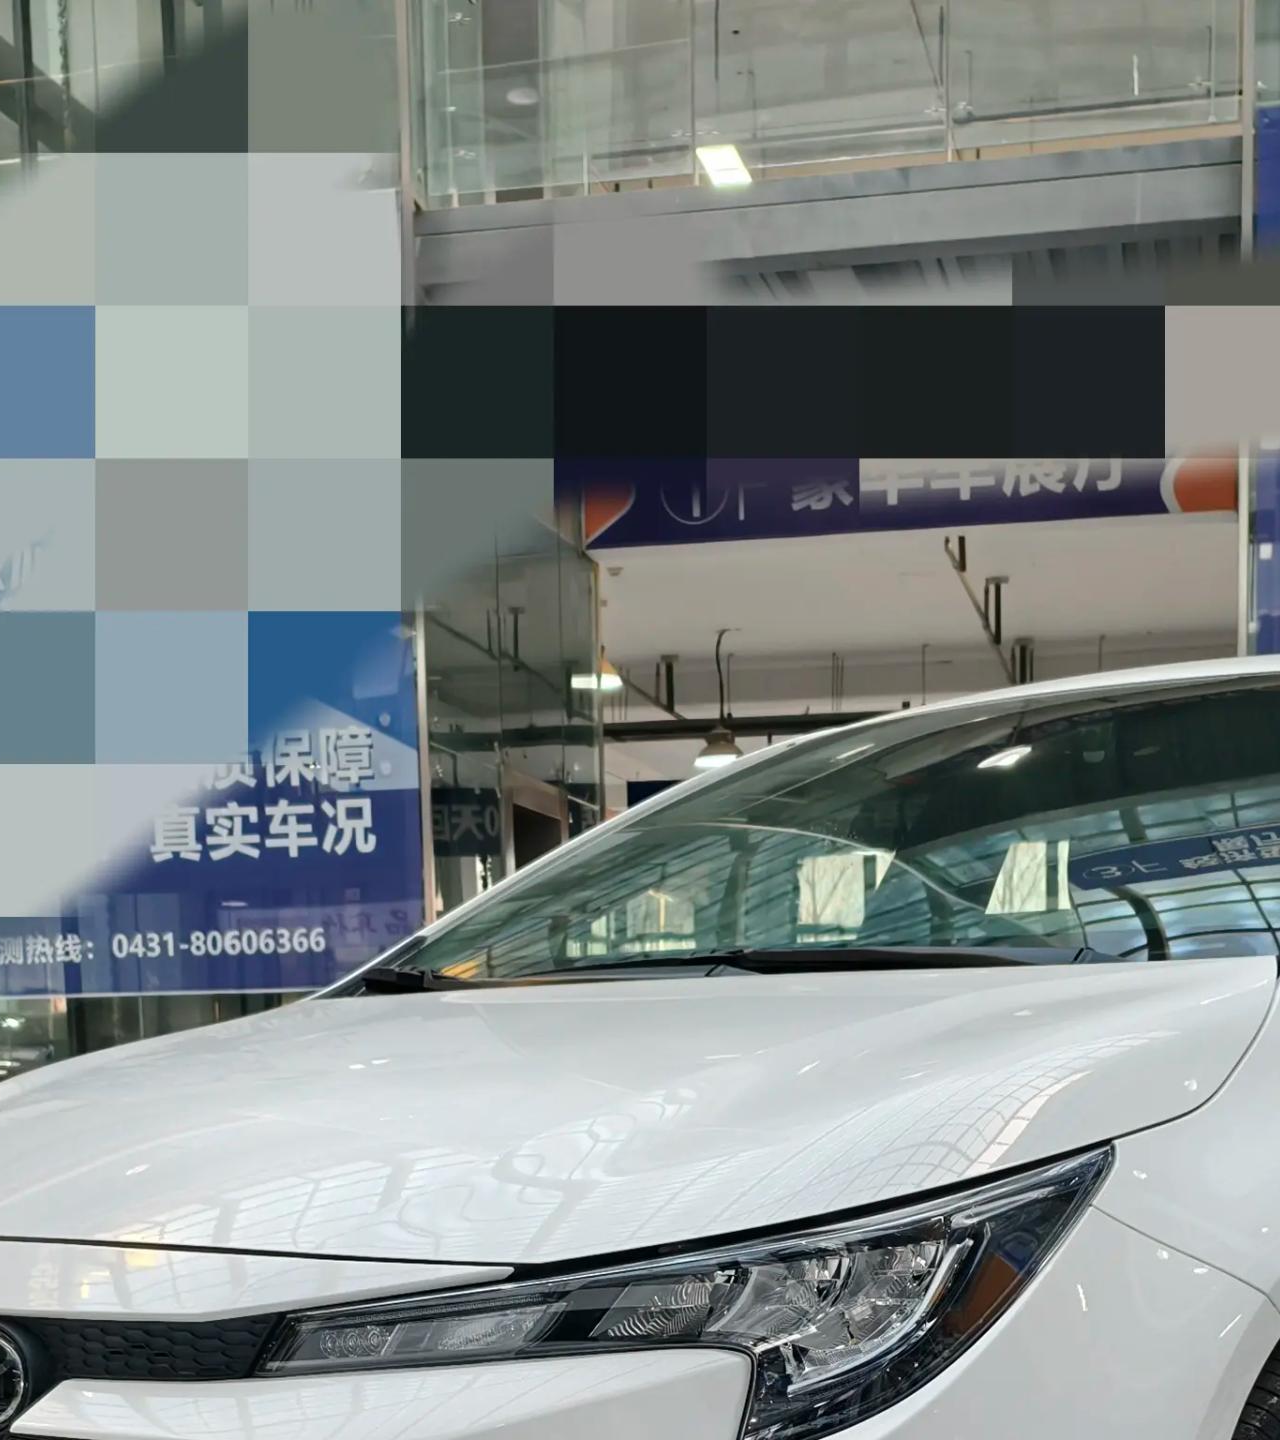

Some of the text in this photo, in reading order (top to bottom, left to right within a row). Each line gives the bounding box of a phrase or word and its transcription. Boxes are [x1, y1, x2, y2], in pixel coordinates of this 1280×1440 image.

[150, 797, 377, 863] 真实车况
[112, 927, 326, 960] 0431-80606366
